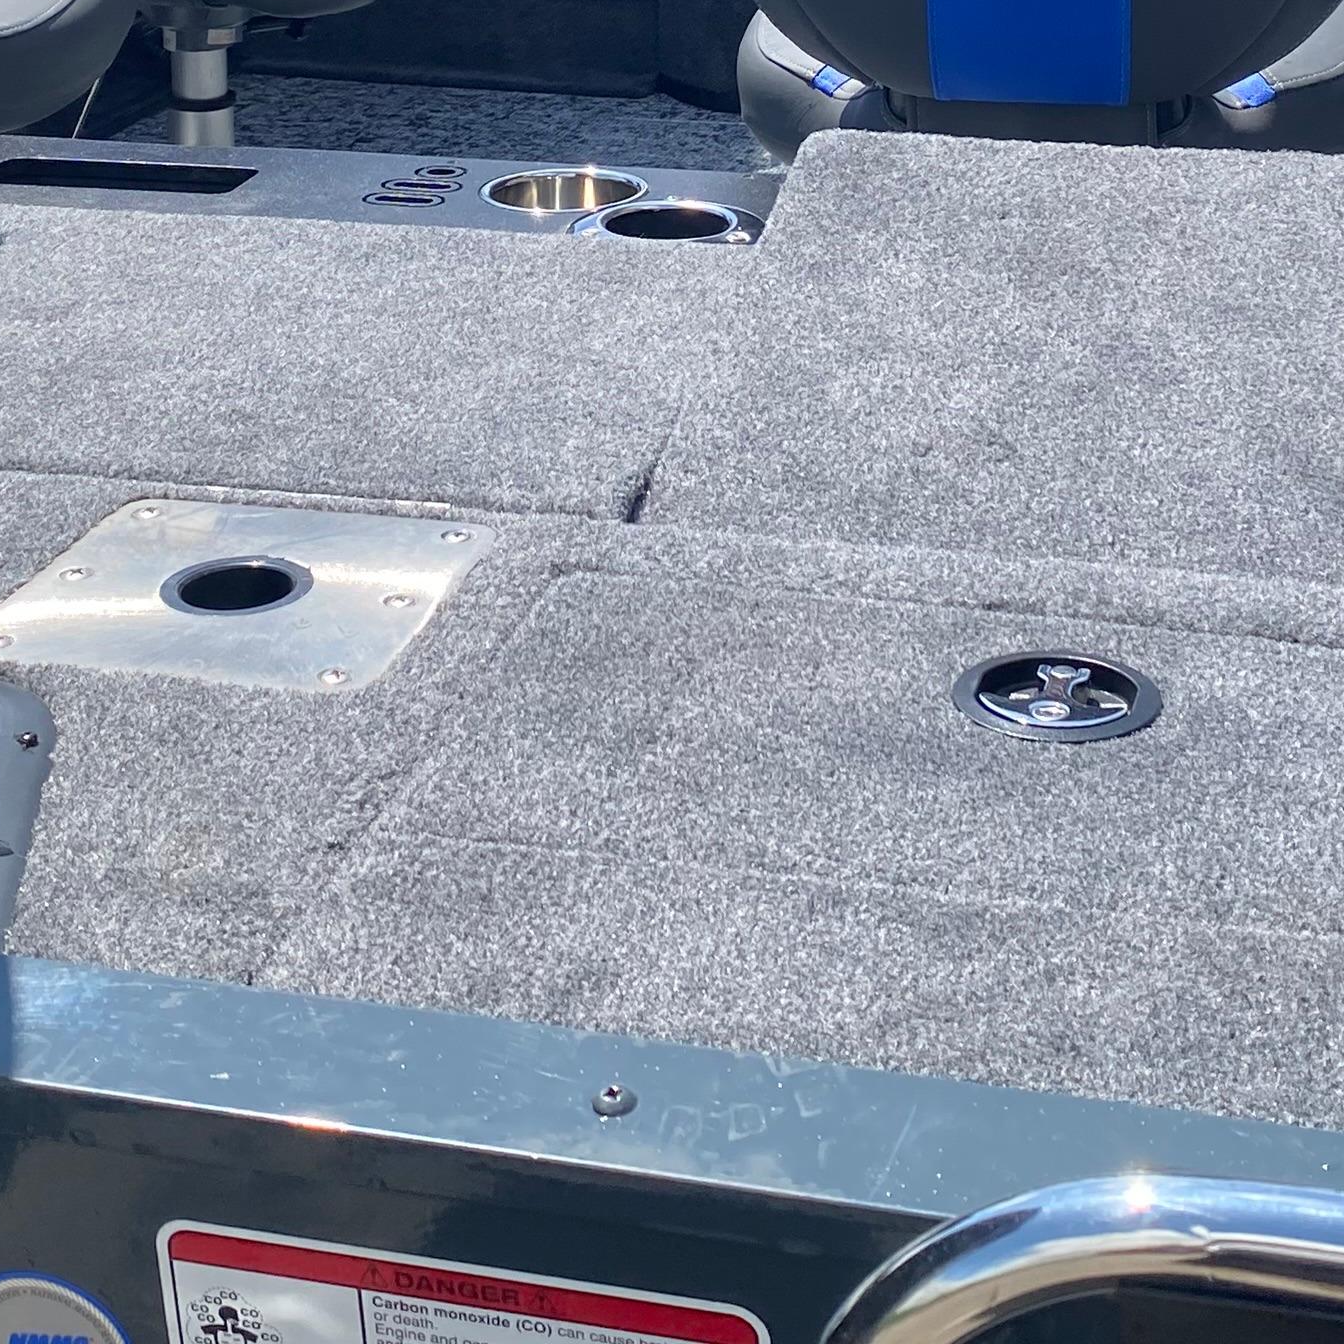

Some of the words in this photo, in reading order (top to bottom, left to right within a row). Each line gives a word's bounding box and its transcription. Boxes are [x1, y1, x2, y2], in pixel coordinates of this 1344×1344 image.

[394, 1271, 520, 1306] DANGER
[372, 1296, 428, 1314] Carbon
[434, 1307, 510, 1328] monoxide
[516, 1319, 552, 1337] (CO)
[558, 1327, 585, 1340] can
[374, 1312, 388, 1322] or
[393, 1313, 438, 1330] death.
[375, 1323, 426, 1342] Engine
[430, 1333, 458, 1344] and
